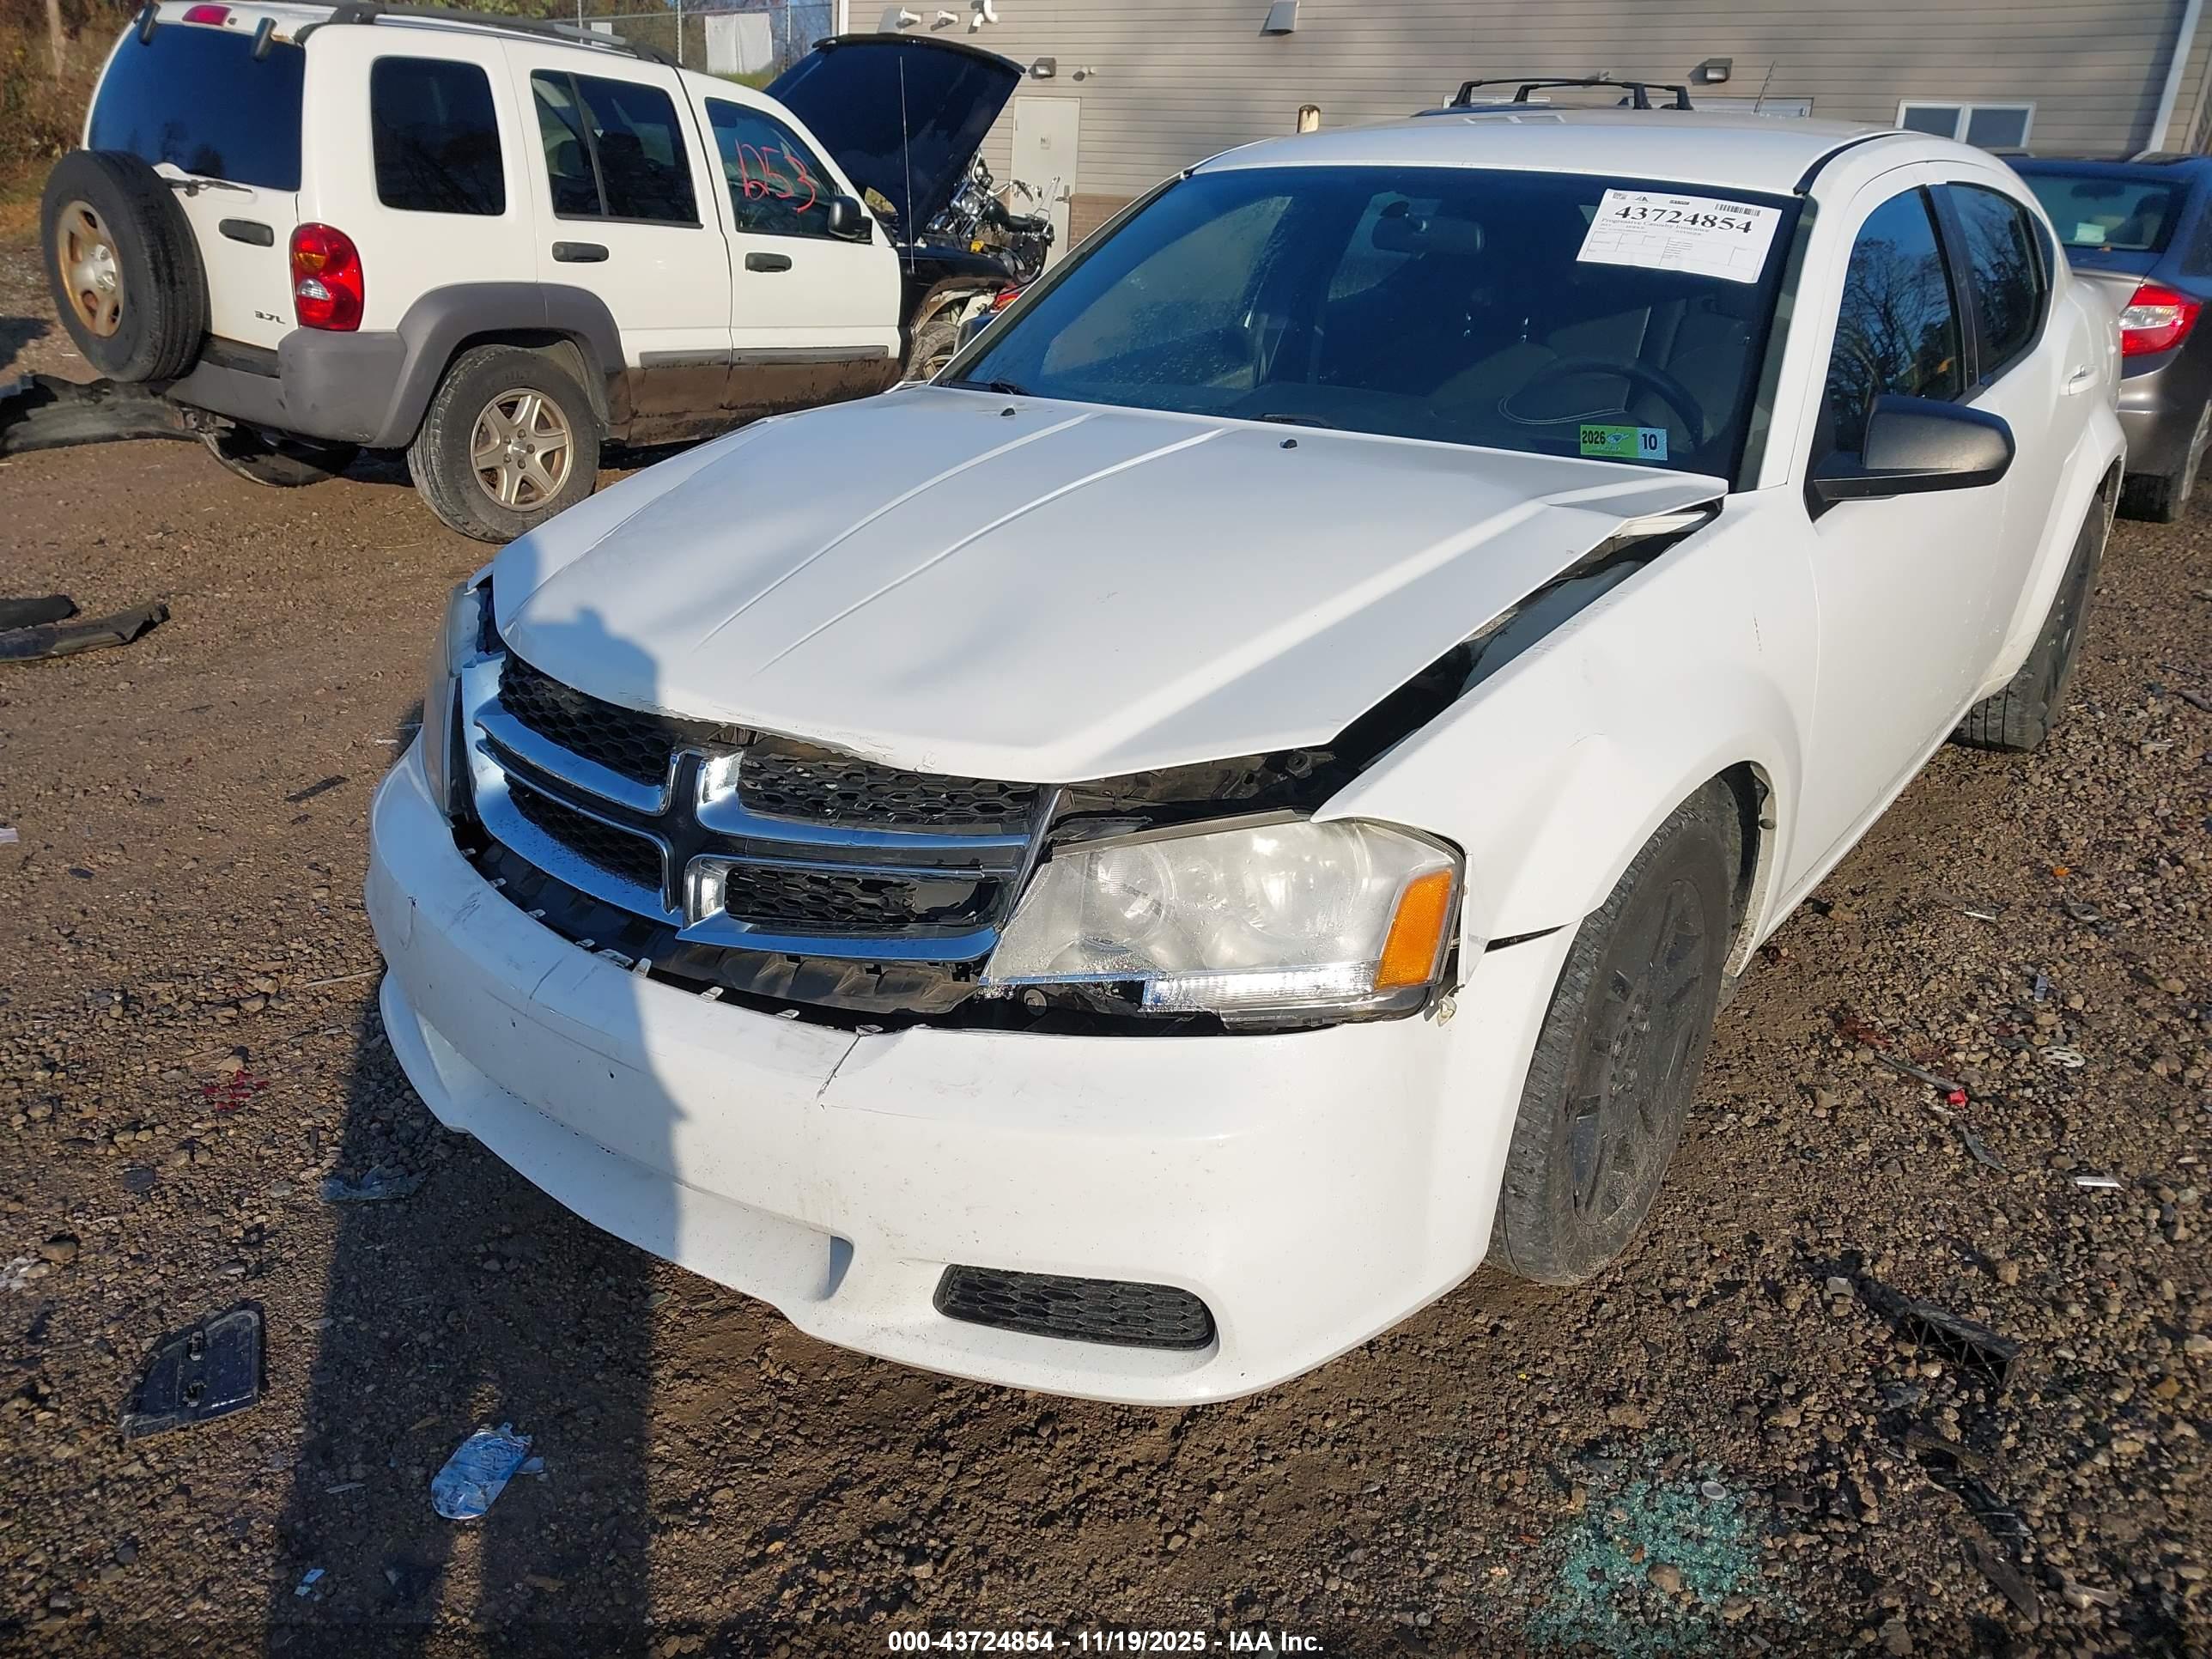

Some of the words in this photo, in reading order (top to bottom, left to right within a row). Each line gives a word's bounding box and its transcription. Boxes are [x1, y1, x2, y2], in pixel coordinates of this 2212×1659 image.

[1614, 205, 1752, 234] 43724854
[1582, 430, 1606, 445] 2026
[1641, 433, 1658, 451] 10
